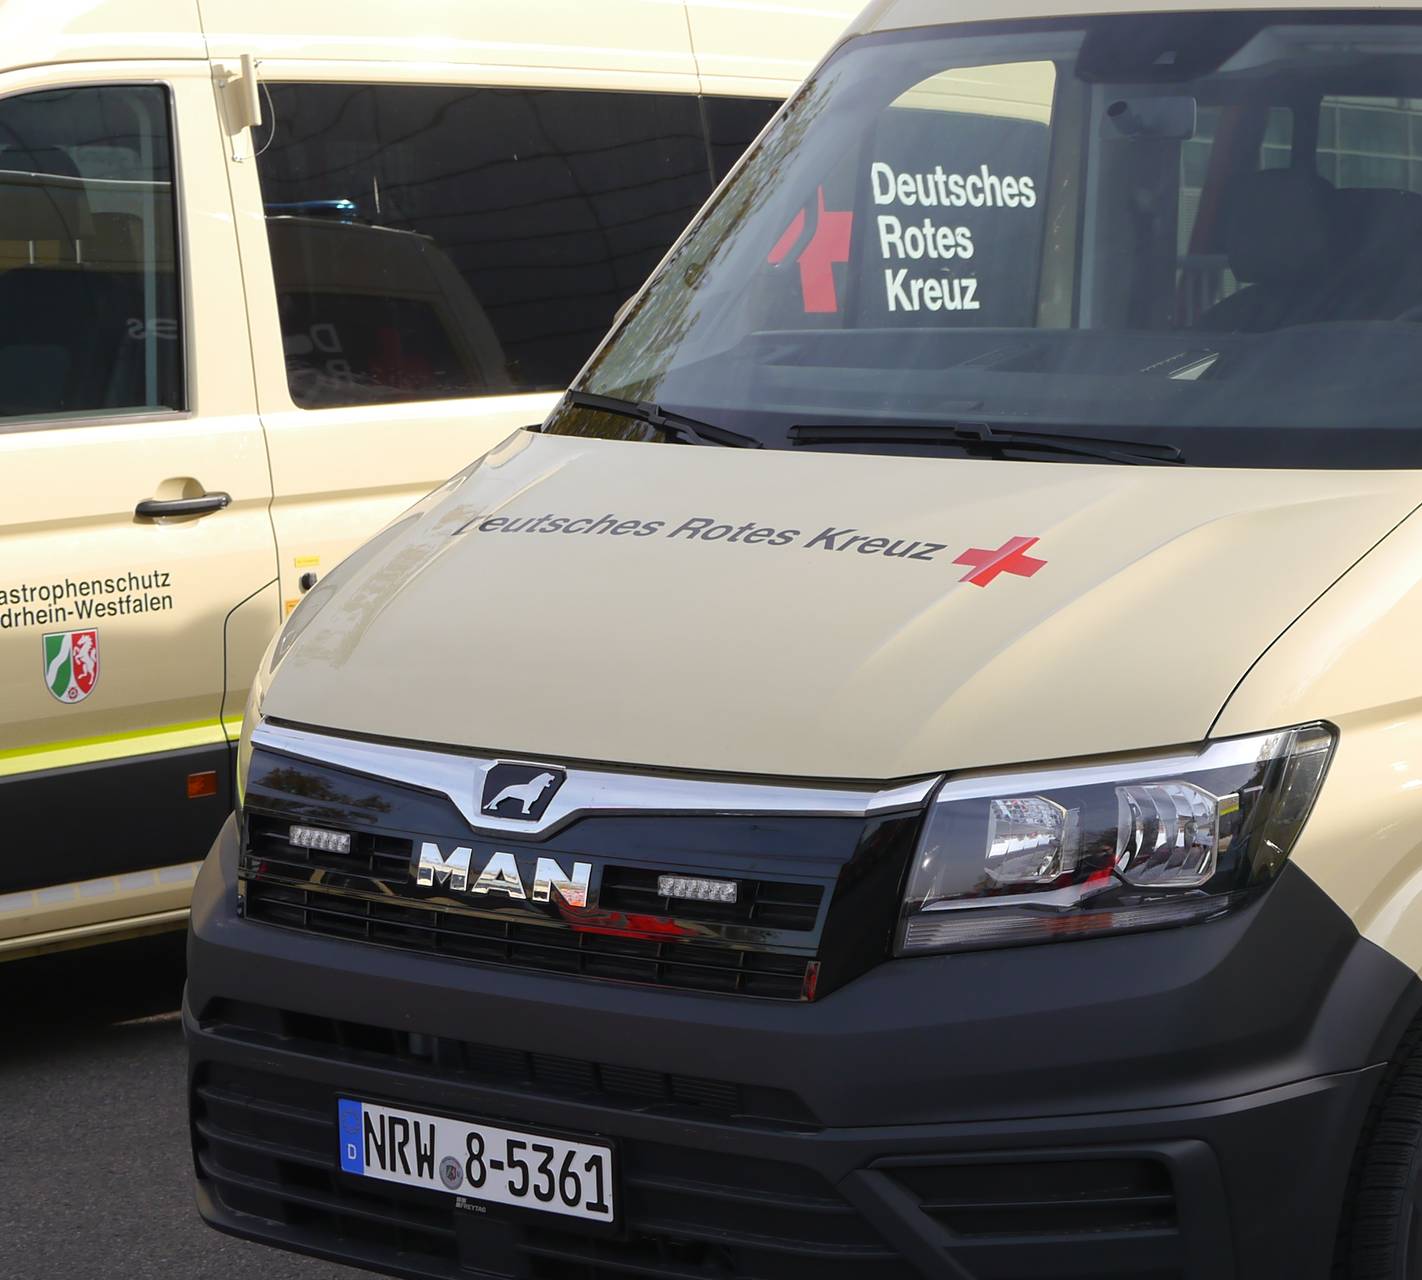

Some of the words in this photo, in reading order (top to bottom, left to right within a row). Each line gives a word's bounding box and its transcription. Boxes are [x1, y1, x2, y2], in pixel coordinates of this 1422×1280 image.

[871, 161, 1037, 208] Deutsches
[877, 215, 975, 260] Rotes
[884, 268, 980, 312] Kreuz
[666, 516, 801, 547] Rotes
[803, 527, 949, 562] Kreuz
[0, 592, 173, 629] drhein-Westfalen
[416, 841, 593, 908] MAN
[347, 1143, 357, 1160] D
[363, 1110, 436, 1180] NRW
[465, 1131, 610, 1215] 8-5361
